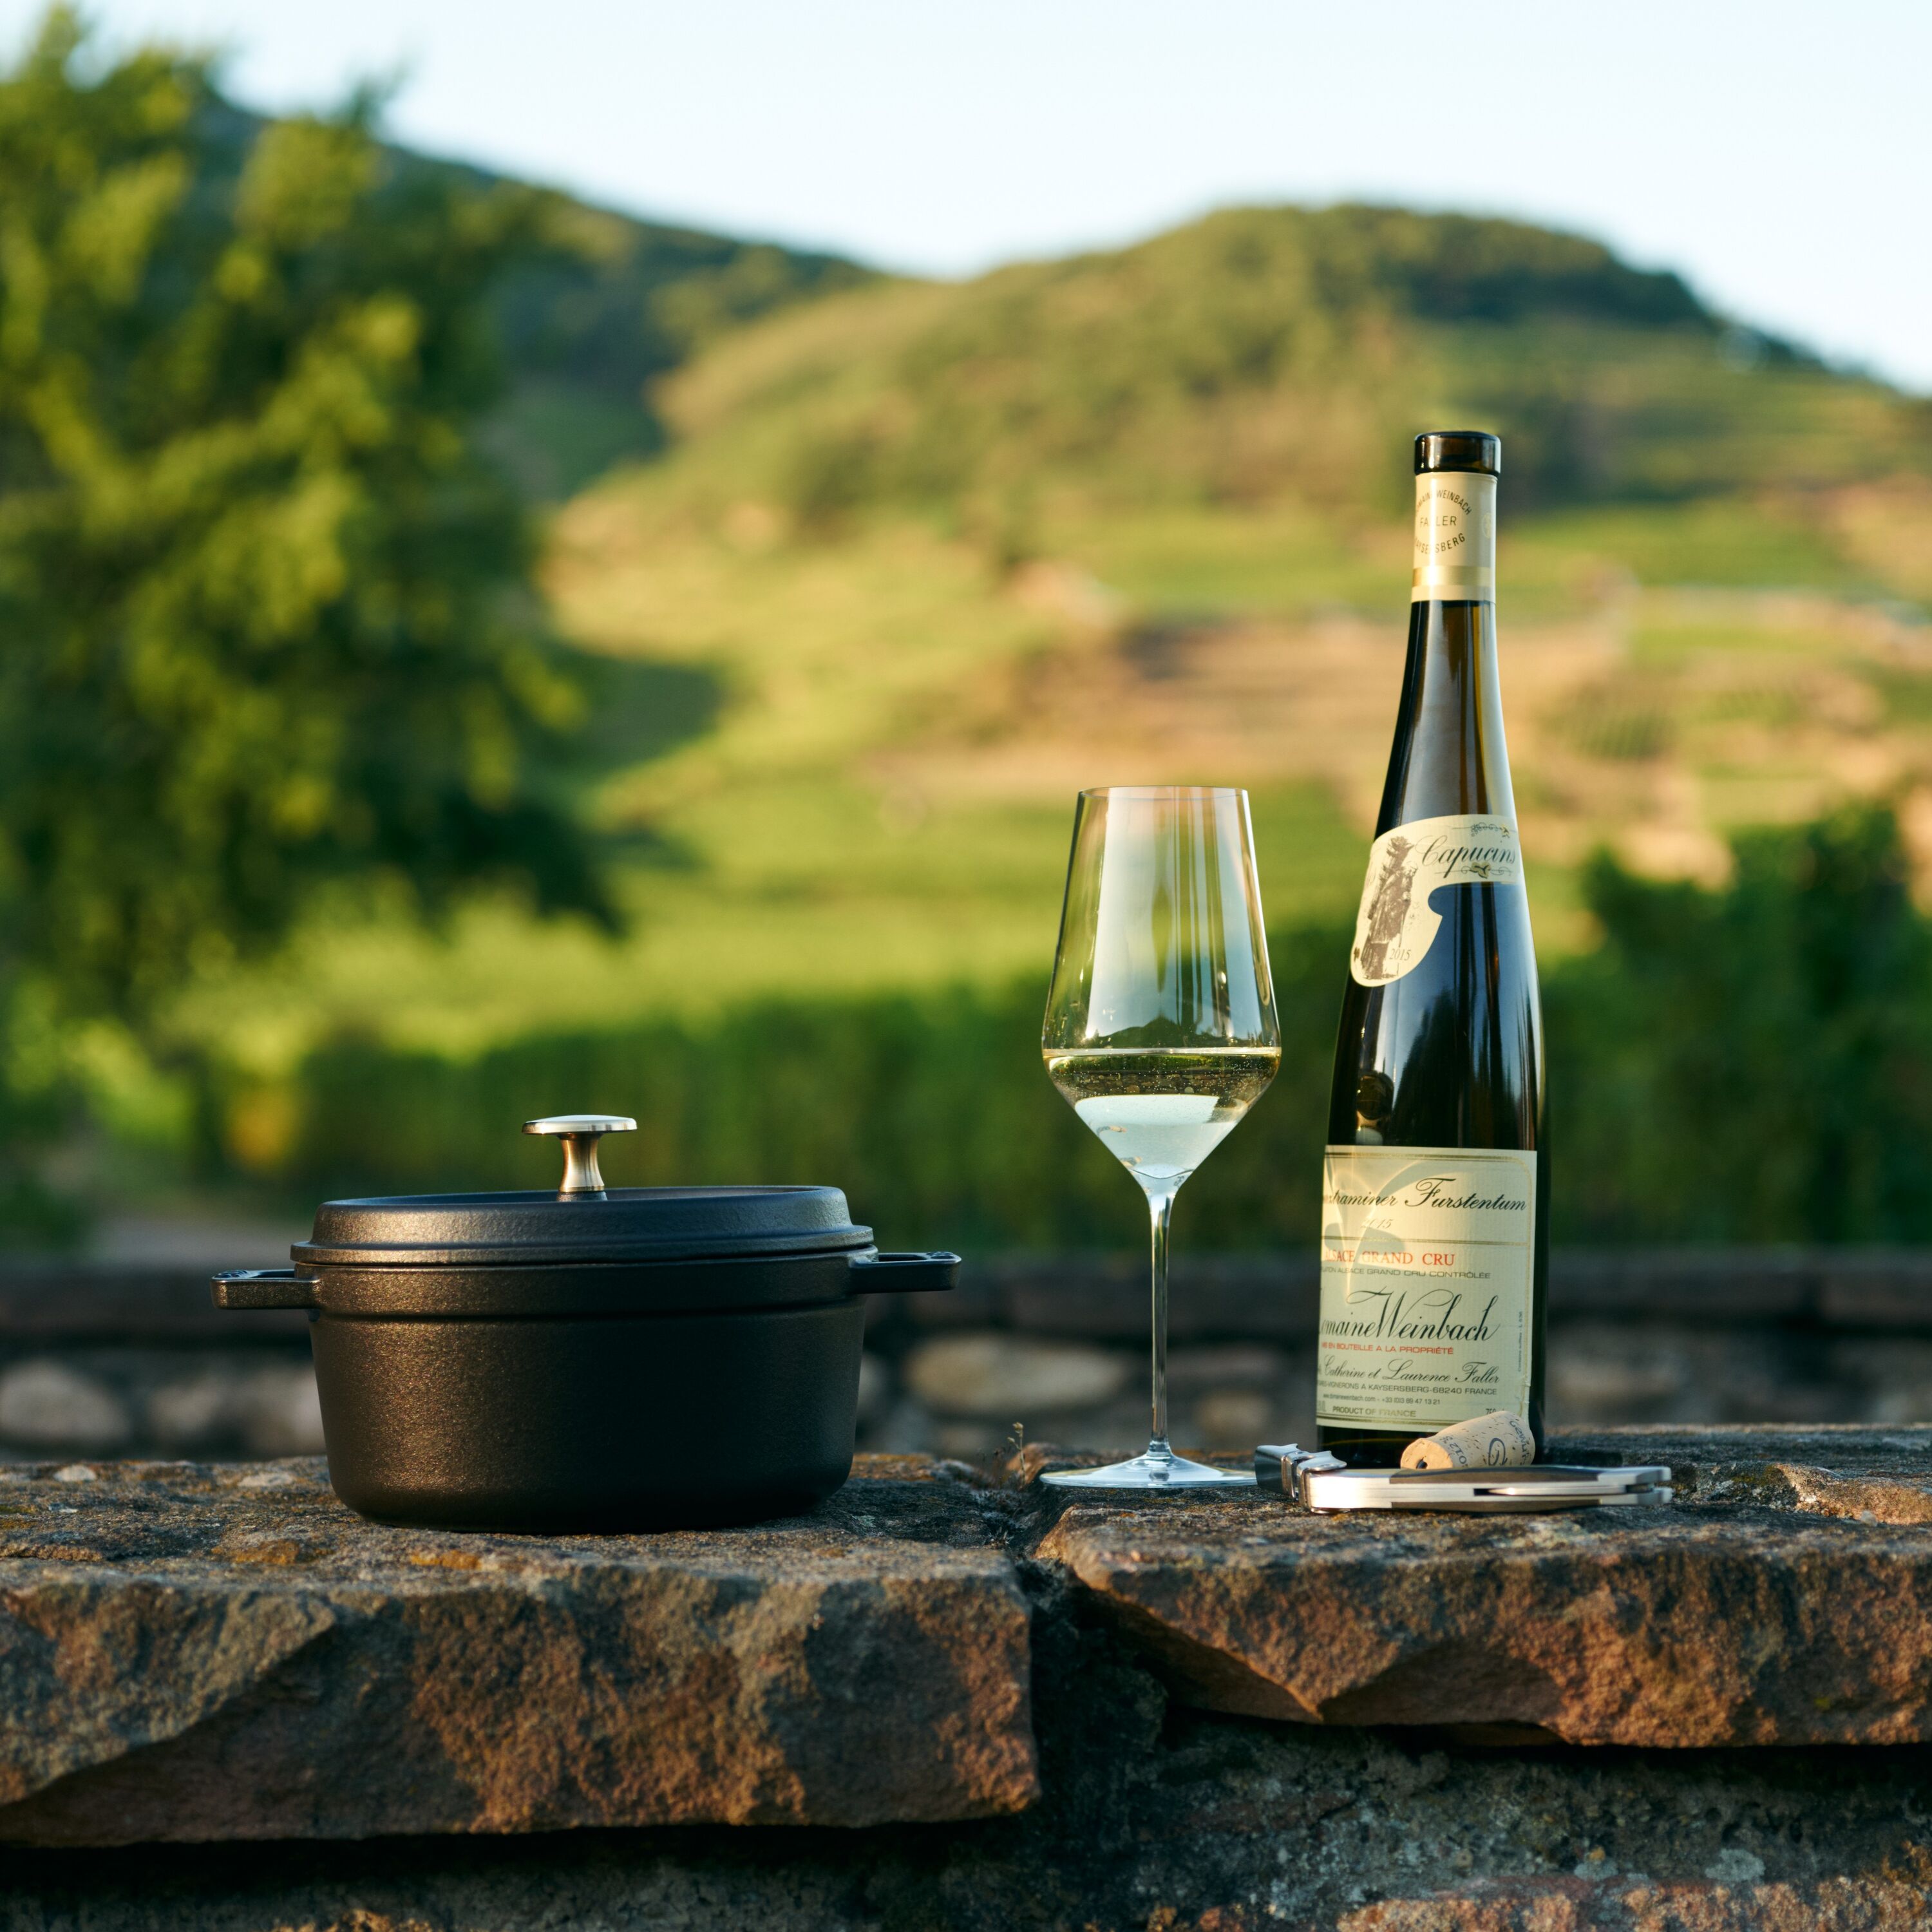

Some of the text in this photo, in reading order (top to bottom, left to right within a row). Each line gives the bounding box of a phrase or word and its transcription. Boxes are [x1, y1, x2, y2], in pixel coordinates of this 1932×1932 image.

[1437, 489, 1472, 515] WEINBACH
[1420, 516, 1457, 527] FALER
[1389, 949, 1411, 961] 2015
[1405, 1177, 1527, 1211] Furstentum
[1362, 1251, 1413, 1265] GRAND
[1422, 1253, 1455, 1266] CRU
[1347, 1285, 1501, 1341] Weinbach
[1336, 1343, 1374, 1351] BOUTEILLE
[1399, 1345, 1454, 1355] PROPRIÉTÉ
[1324, 1354, 1366, 1378] Catherine
[1368, 1368, 1382, 1379] et
[1382, 1358, 1452, 1382] Laurence
[1455, 1361, 1501, 1383] Faller
[1332, 1406, 1363, 1415] PRODUCT
[1379, 1408, 1417, 1417] FRANCE
